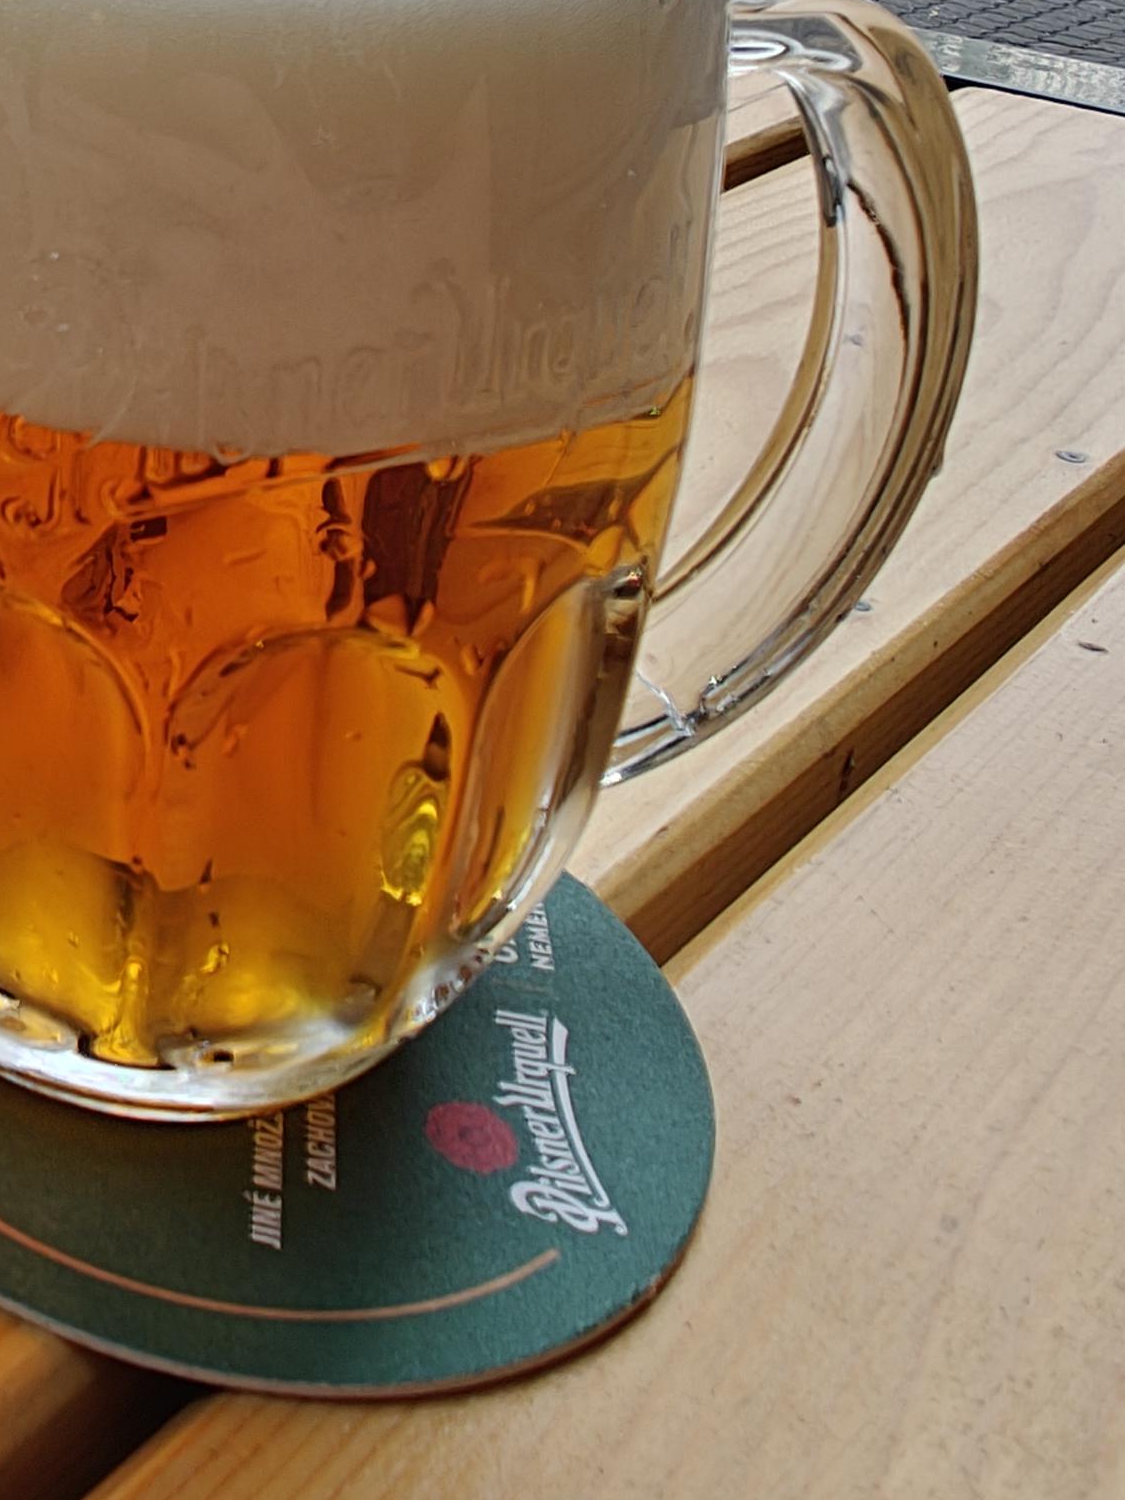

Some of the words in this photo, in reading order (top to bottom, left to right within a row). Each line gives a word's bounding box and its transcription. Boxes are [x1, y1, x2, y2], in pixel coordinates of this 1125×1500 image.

[492, 1008, 577, 1108] Urquell
[250, 1111, 284, 1191] MNOŽ
[306, 1092, 336, 1191] ZACHOV
[509, 1102, 628, 1237] Pilsner
[246, 1189, 283, 1250] JINÉ
